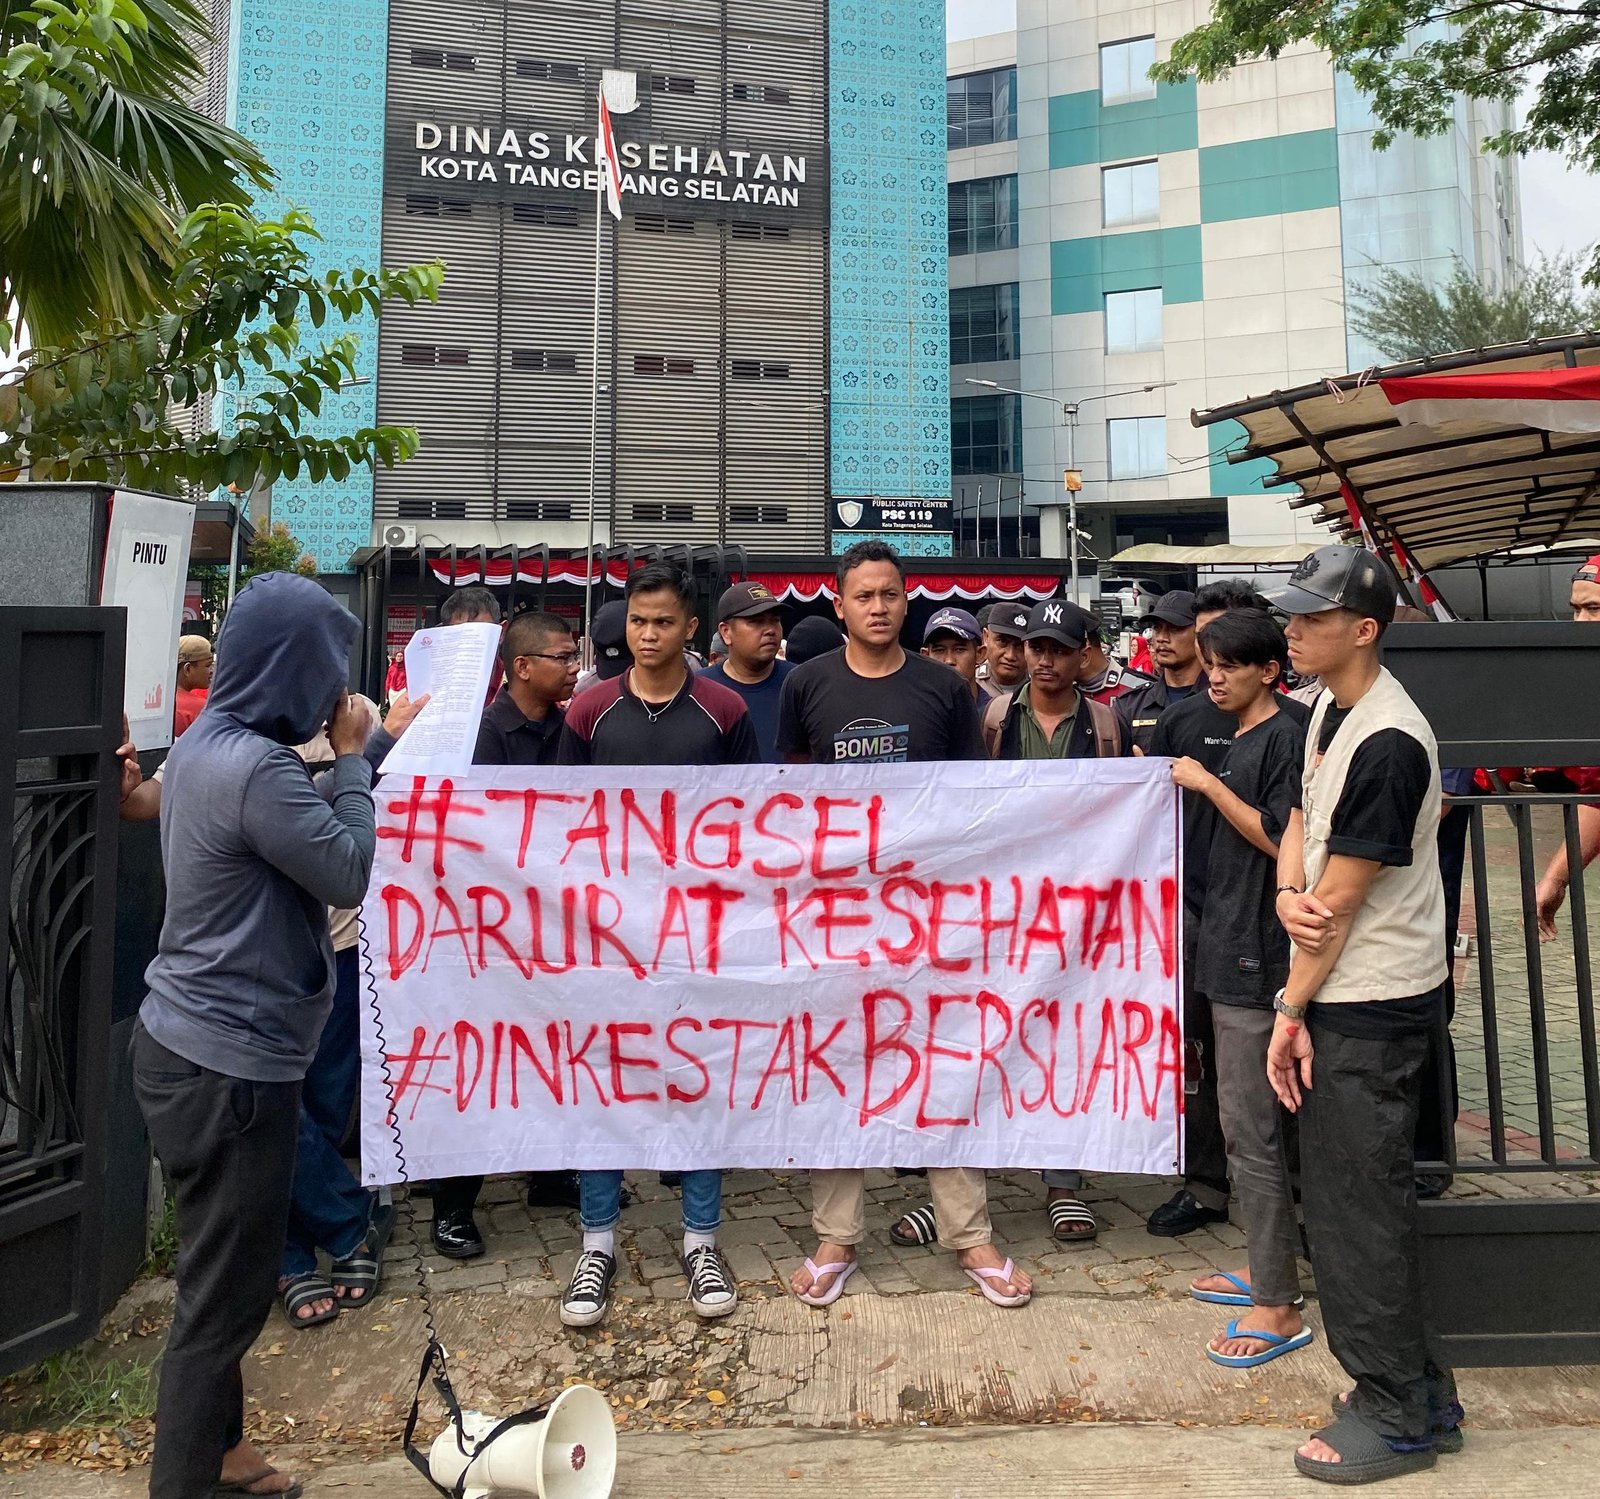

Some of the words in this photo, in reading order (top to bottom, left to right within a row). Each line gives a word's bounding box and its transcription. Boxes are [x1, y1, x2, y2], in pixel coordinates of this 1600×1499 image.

[415, 122, 550, 160] DINAS
[420, 156, 498, 182] KOTA
[684, 179, 799, 207] SELATAN
[881, 510, 906, 520] PSC
[909, 510, 933, 521] 119
[132, 541, 168, 565] PINTU
[376, 775, 915, 879] #TANGSEL
[381, 884, 745, 980] DARURAT
[772, 875, 1176, 979] KESEHATAN
[386, 989, 1184, 1128] #DINKESTAKBERSUARA
